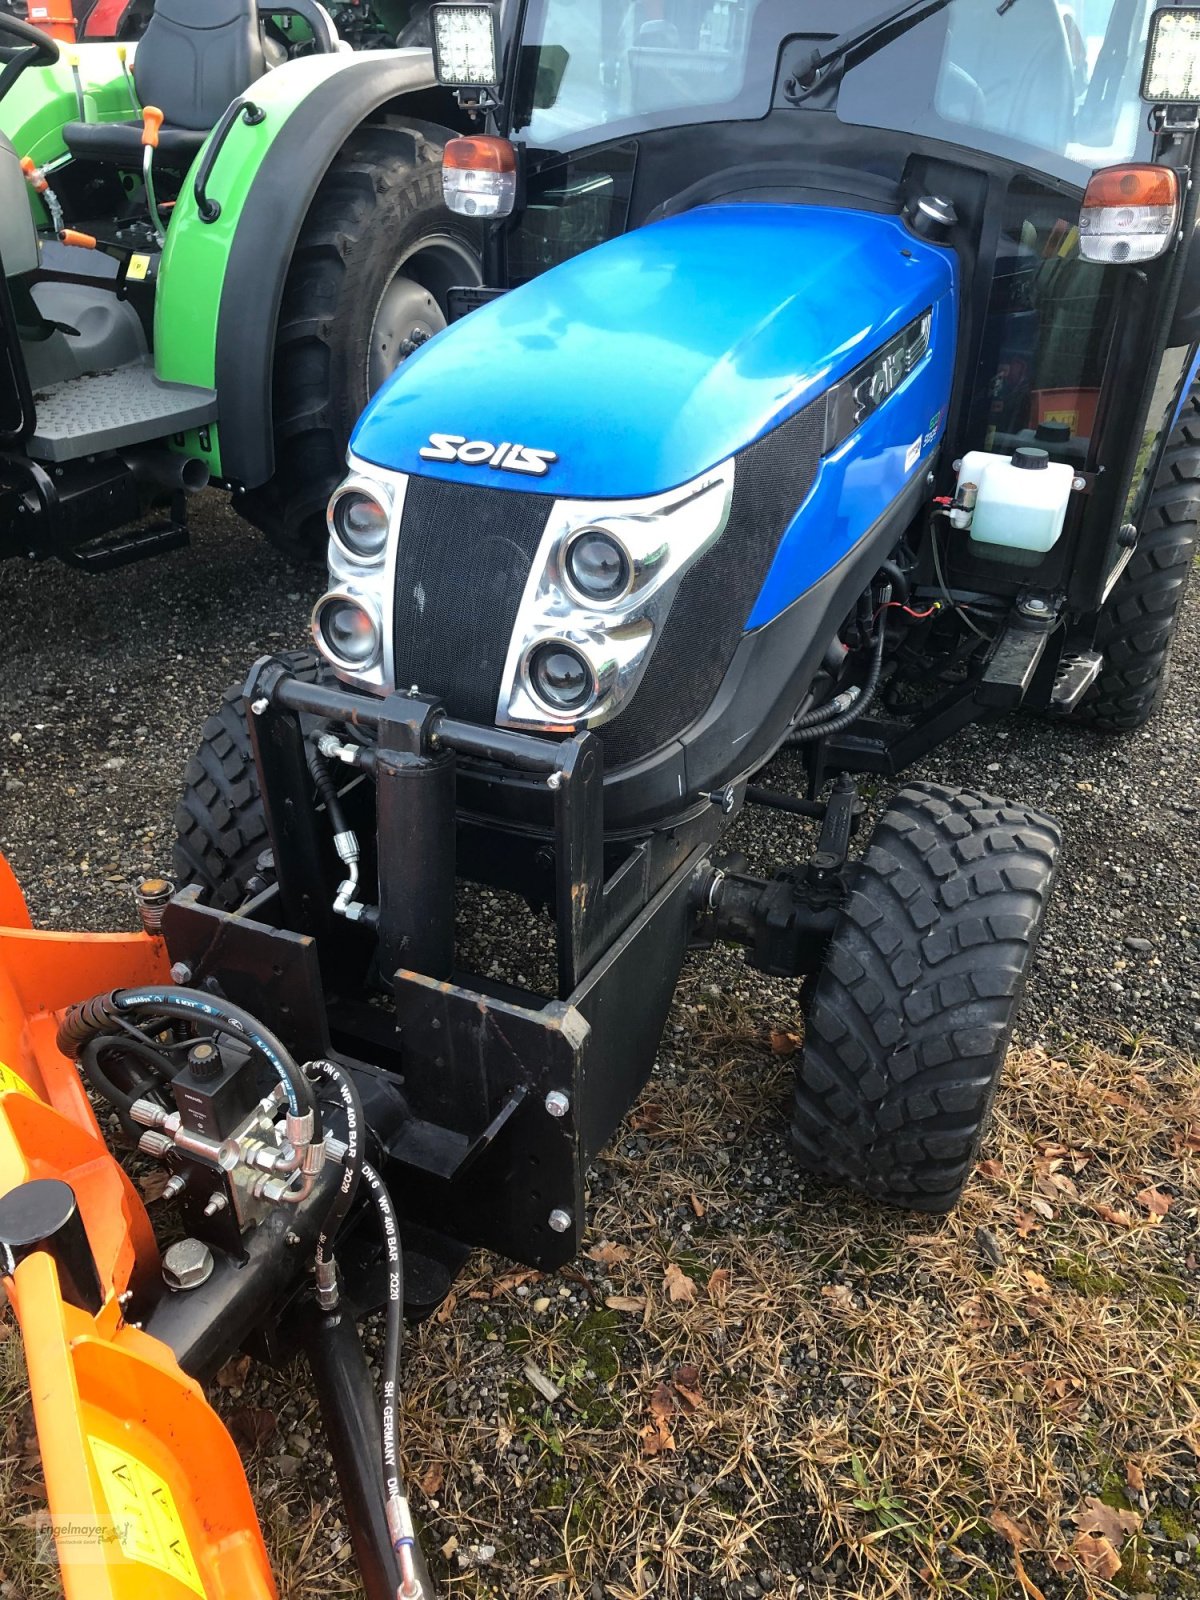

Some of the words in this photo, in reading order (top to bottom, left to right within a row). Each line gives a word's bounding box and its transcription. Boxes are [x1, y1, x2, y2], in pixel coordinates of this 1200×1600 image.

[323, 1063, 335, 1075] DN
[333, 1072, 340, 1080] 6
[340, 1084, 352, 1104] WP
[346, 1107, 356, 1128] 400
[348, 1131, 357, 1158] BAR
[361, 1165, 376, 1181] DN
[371, 1178, 380, 1189] 6
[378, 1195, 390, 1214] WP
[384, 1216, 395, 1235] 400
[387, 1238, 398, 1262] BAR
[390, 1272, 399, 1300] 2Q20
[384, 1381, 394, 1397] SH
[383, 1406, 395, 1466] GERMANY
